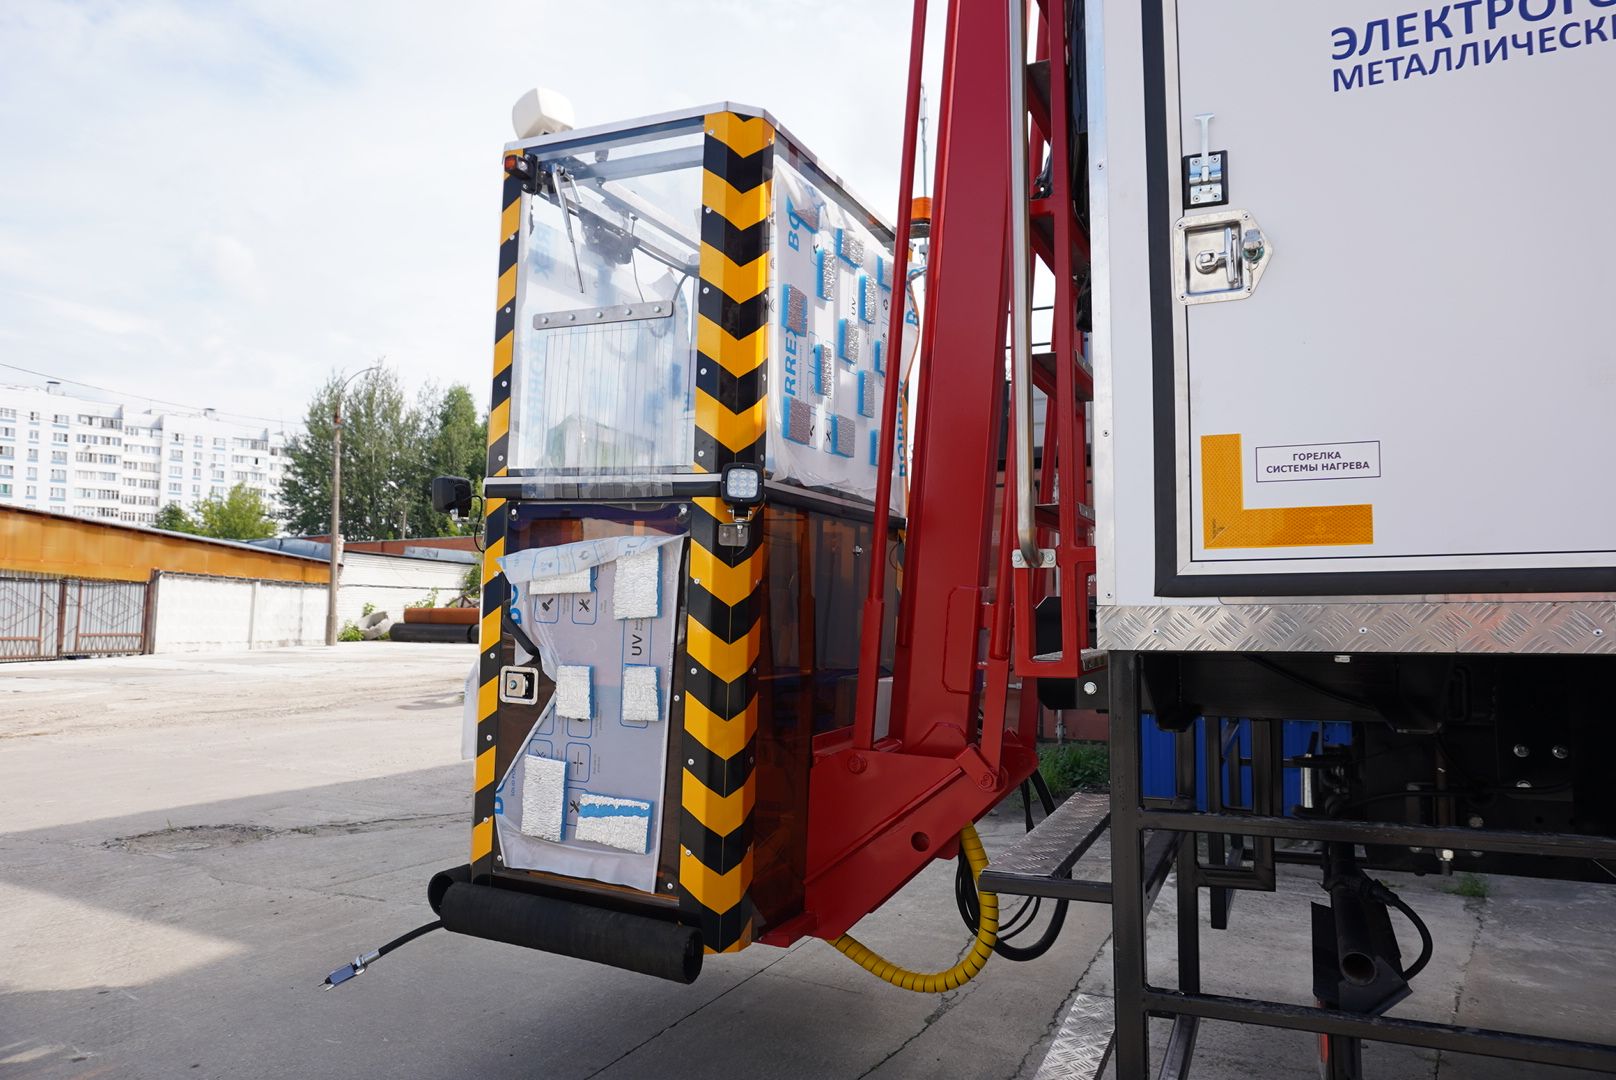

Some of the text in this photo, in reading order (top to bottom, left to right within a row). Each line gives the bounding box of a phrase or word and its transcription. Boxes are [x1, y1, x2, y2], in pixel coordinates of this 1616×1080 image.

[1331, 0, 1616, 60] ЭЛЕКТРО
[1333, 14, 1616, 92] МЕТАЛЛИЧЕСК
[1292, 451, 1341, 461] ГОРЕЛКА
[1266, 461, 1370, 474] СИСТЕМЫ НАГРЕВА
[631, 634, 642, 656] UV
